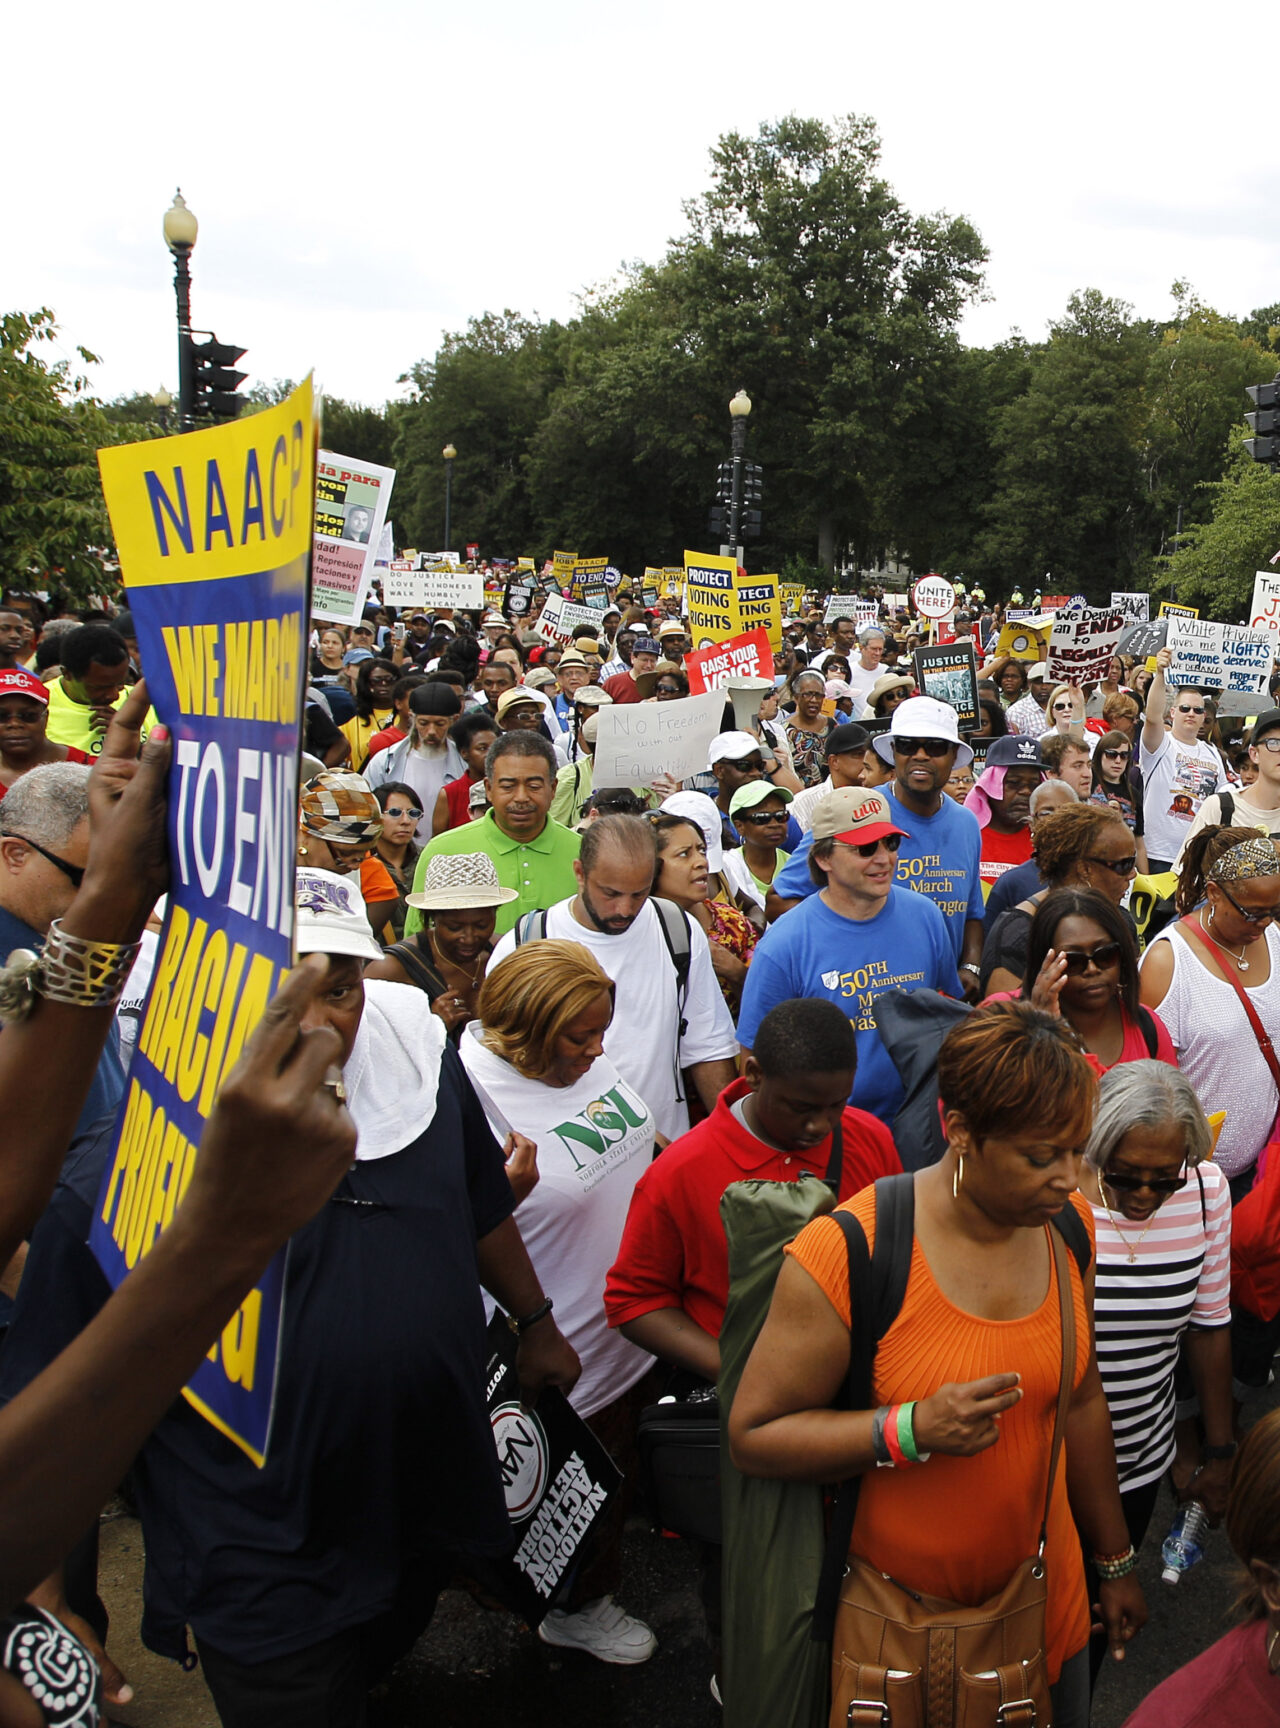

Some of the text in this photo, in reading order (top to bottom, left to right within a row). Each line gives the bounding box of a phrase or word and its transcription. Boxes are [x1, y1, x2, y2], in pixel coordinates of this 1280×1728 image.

[338, 470, 381, 488] para
[412, 572, 455, 580] JUSTICE
[575, 574, 587, 583] TO
[588, 572, 605, 583] END
[688, 567, 729, 587] PROTECT
[423, 582, 473, 590] KINDNESS
[423, 591, 461, 599] HUMBLY
[781, 590, 800, 598] LAW
[918, 585, 953, 598] UNITE
[1260, 579, 1280, 594] THE
[689, 588, 730, 609] VOTING
[917, 596, 951, 608] HERE!
[563, 610, 602, 623] ENVIRONMEN
[565, 604, 592, 616] PROTECT
[739, 602, 771, 617] TING
[857, 613, 877, 621] LITY
[1055, 605, 1127, 621] We Demand
[690, 609, 732, 630] RIGHTS
[1053, 615, 1124, 637] an END
[1176, 617, 1270, 645] White Privilege
[1071, 637, 1090, 645] to
[1170, 638, 1194, 651] gives
[1199, 640, 1216, 649] me
[1221, 640, 1271, 659] RIGHTS
[700, 643, 759, 677] RAISE YOUR
[1048, 641, 1118, 662] LEGALLY
[1177, 651, 1268, 669] everyone deserves
[922, 654, 970, 668] JUSTICE
[944, 664, 970, 672] COURTS
[162, 626, 219, 716] WE
[1165, 668, 1222, 687] JUSTICE FOR
[1229, 671, 1260, 681] PEOPLE
[1227, 683, 1254, 693] COLOR
[613, 709, 708, 736] No Freedom
[177, 740, 226, 898] TO
[896, 855, 941, 881] 50TH
[923, 869, 967, 879] Anniversary
[910, 878, 953, 893] March
[840, 960, 888, 997] 50TH
[870, 969, 925, 988] Anniversary
[546, 1079, 648, 1172] NSU
[513, 1450, 585, 1572] NETWORK
[526, 1466, 594, 1590] ACTION
[536, 1481, 608, 1599] NATIONAL
